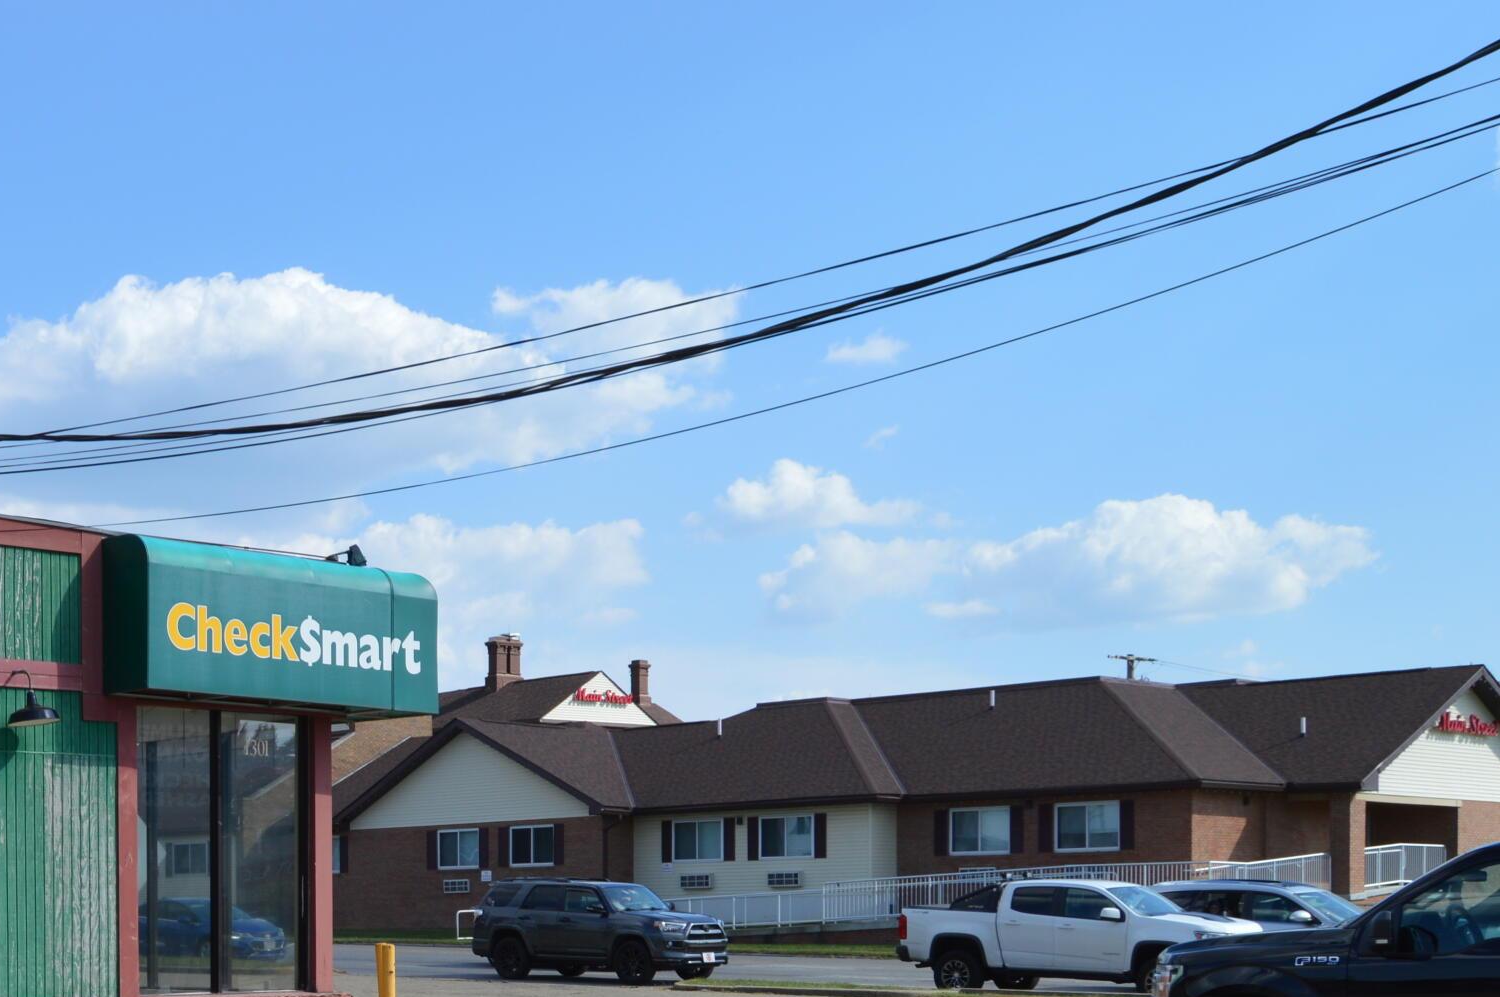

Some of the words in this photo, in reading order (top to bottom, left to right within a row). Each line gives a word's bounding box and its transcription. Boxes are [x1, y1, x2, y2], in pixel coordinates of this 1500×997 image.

[575, 687, 602, 702] Main
[603, 690, 634, 704] Street
[1437, 711, 1467, 732] Main
[243, 739, 269, 756] 1301
